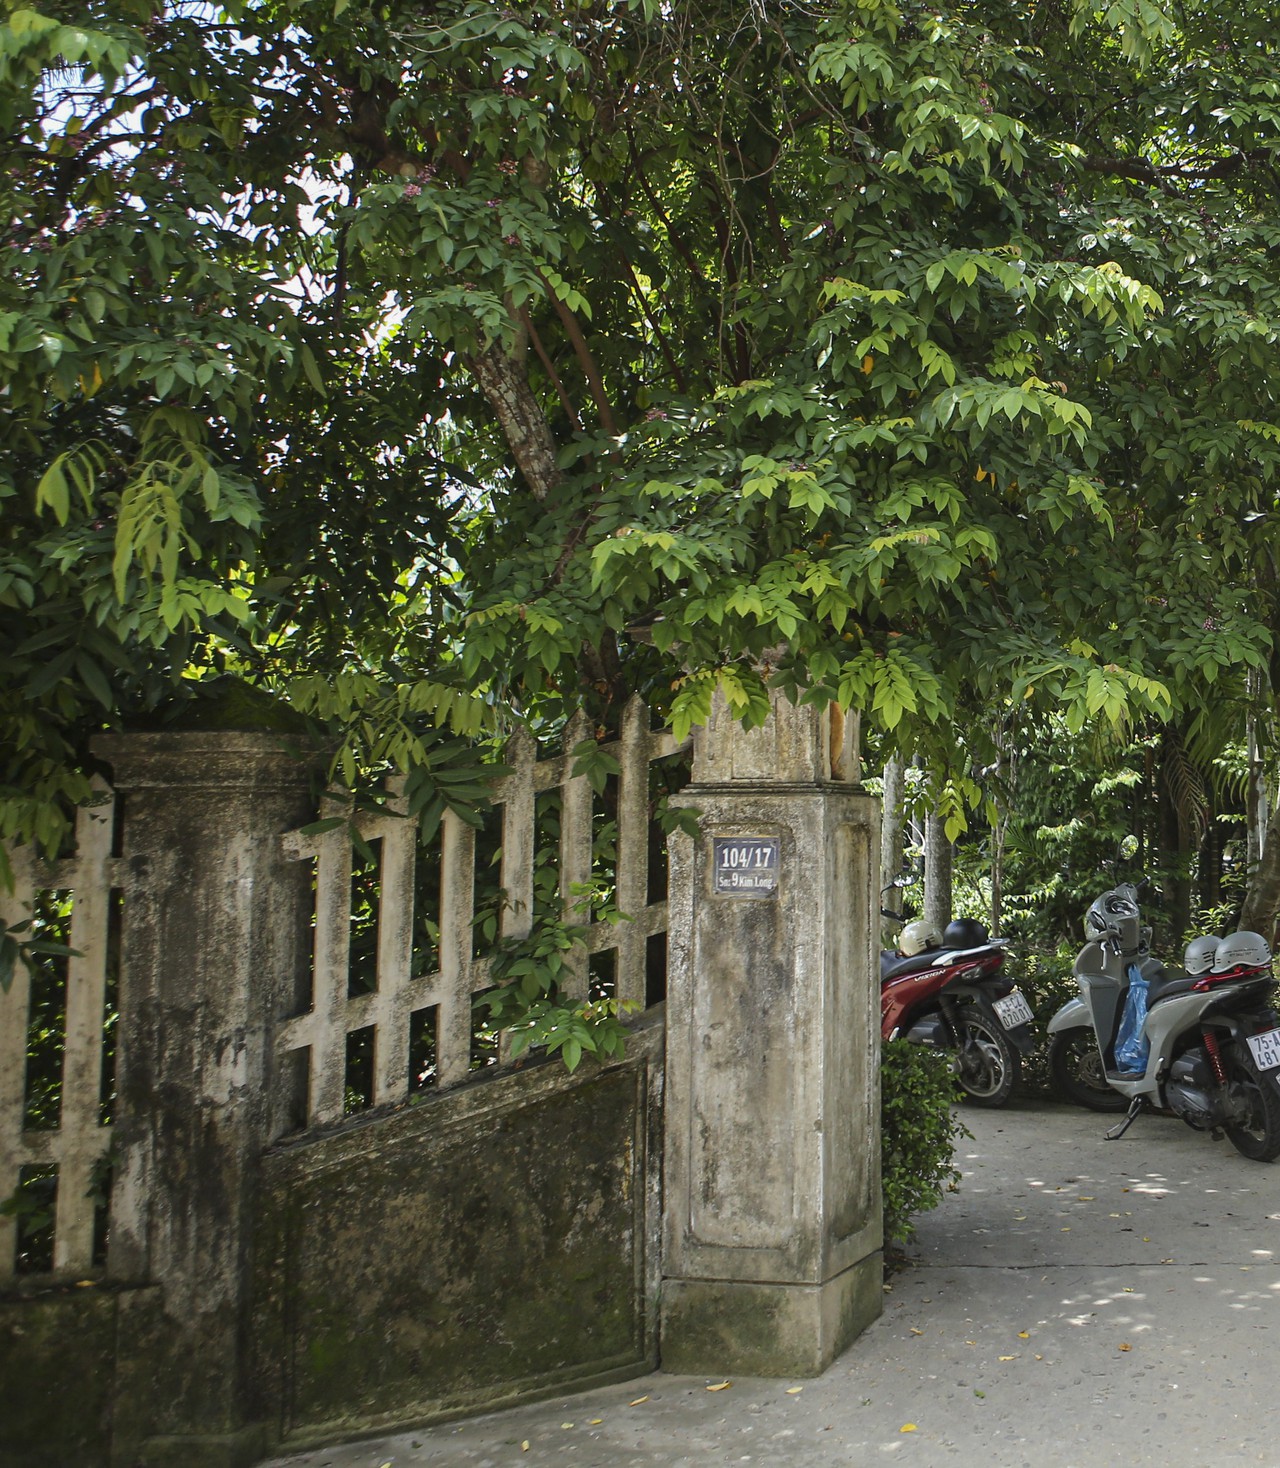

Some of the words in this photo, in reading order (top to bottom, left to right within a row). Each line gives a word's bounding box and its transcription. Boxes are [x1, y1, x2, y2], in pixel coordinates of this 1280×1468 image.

[721, 847, 772, 868] 104/17
[731, 872, 739, 887] 9
[739, 876, 753, 888] Kim
[754, 876, 774, 889] Long
[1002, 1006, 1030, 1028] 020.01
